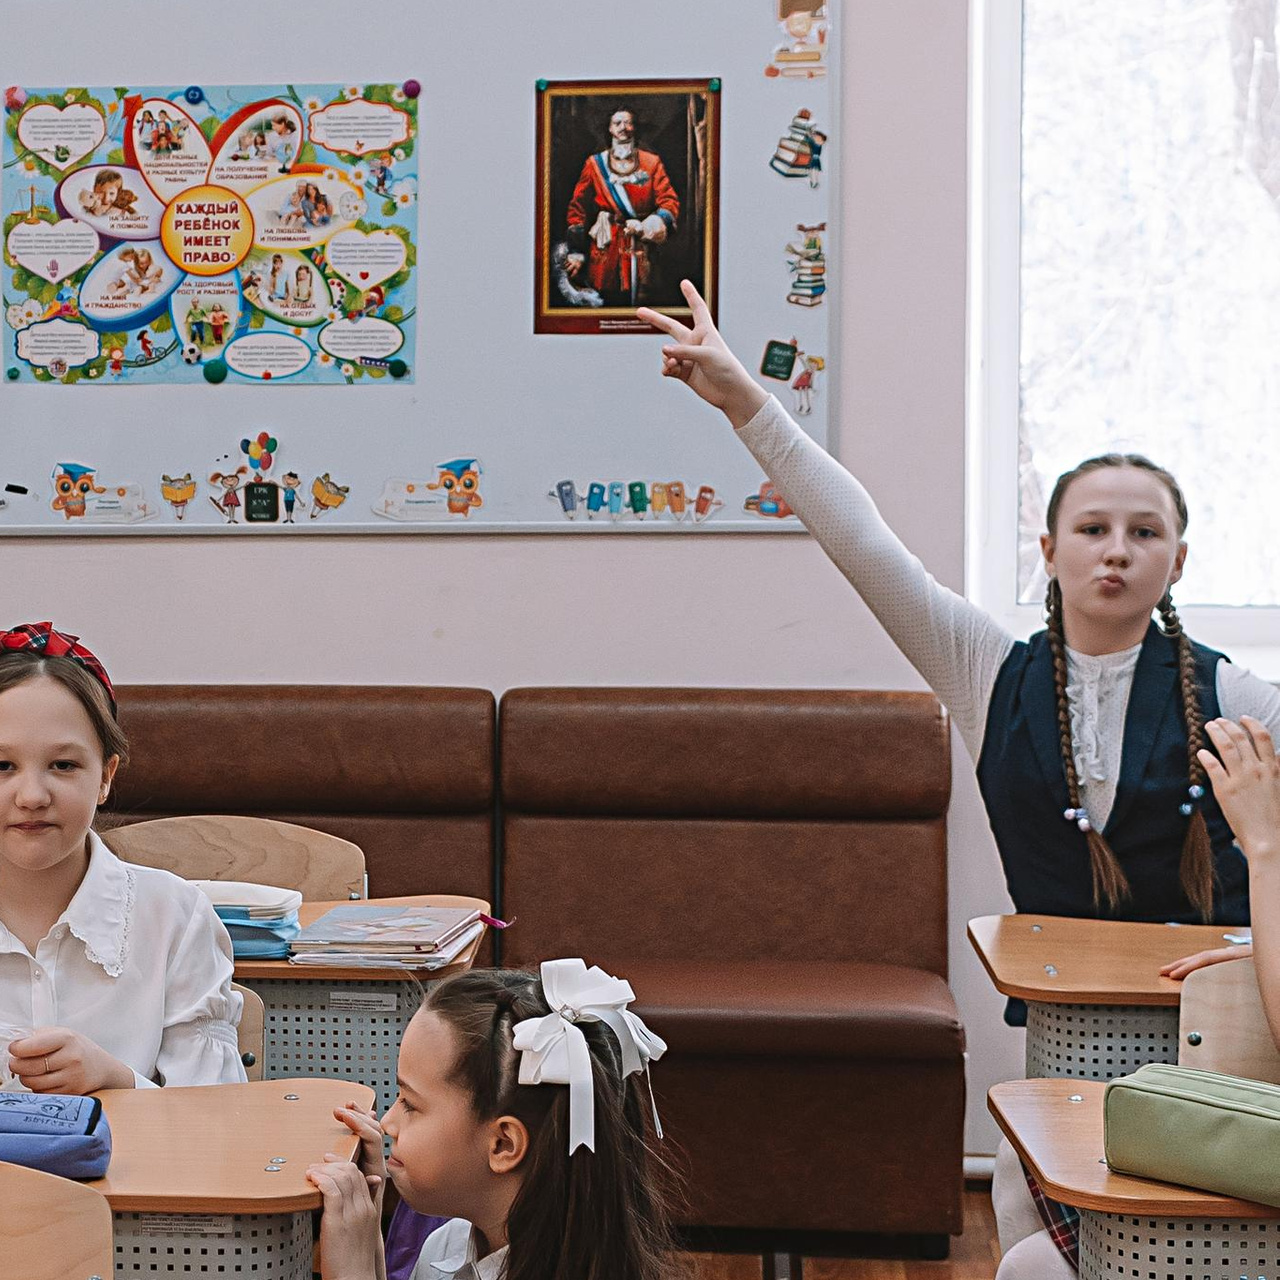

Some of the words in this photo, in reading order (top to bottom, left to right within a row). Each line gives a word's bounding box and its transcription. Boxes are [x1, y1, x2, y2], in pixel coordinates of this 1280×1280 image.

[176, 201, 238, 215] КАЖДЫЙ
[175, 218, 240, 231] РЕБЁНОК
[184, 236, 231, 246] ИМЕЕТ
[184, 252, 235, 262] ПРАВО:
